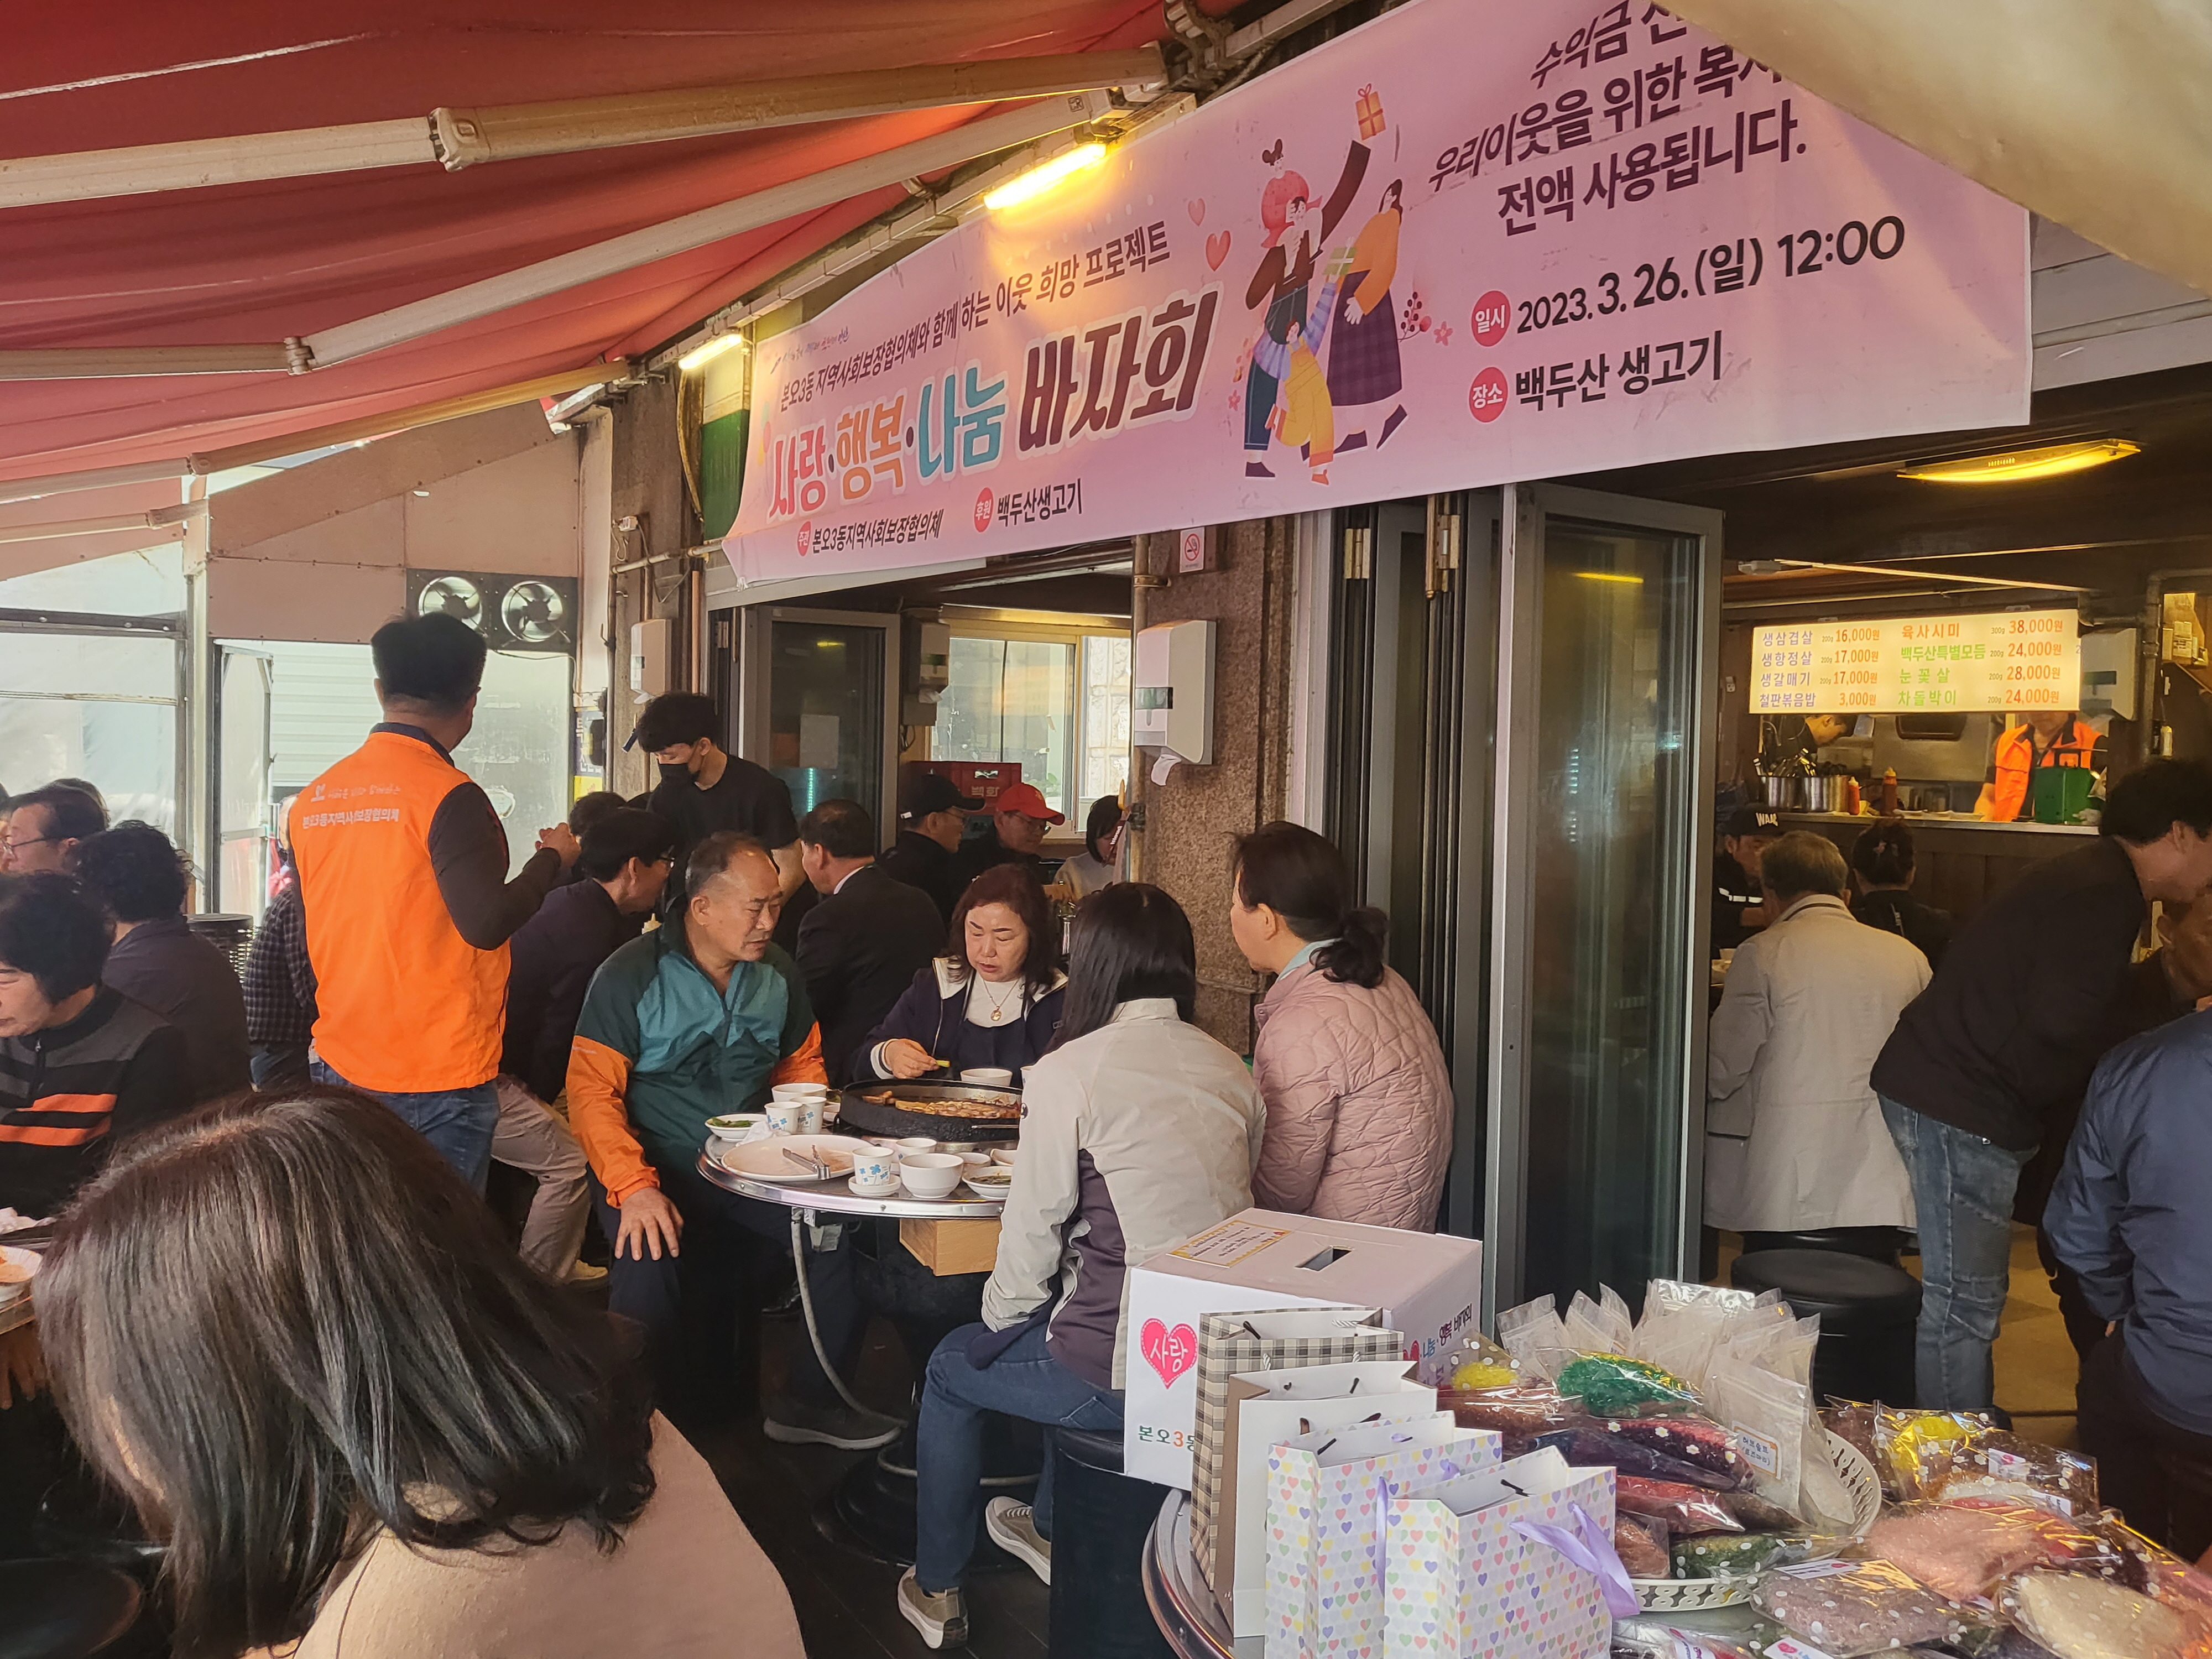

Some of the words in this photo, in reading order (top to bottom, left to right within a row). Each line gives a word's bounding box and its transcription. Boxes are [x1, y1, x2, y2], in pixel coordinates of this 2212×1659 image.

[1530, 0, 1632, 89] 수익금
[1429, 90, 1593, 192] 우리이웃을
[1603, 56, 1687, 133] 위한
[1498, 166, 1574, 236] 전액
[1583, 99, 1806, 209] 사용됩니다.
[1475, 304, 1506, 333] 일시
[1777, 215, 1906, 277] 12:00
[780, 371, 815, 413] 본오3동
[816, 317, 931, 395] 지역사회보장협의체와
[932, 301, 959, 348] 함께
[962, 290, 991, 332] 하는
[997, 273, 1032, 317] 이웃
[1036, 254, 1079, 303] 희망
[1083, 220, 1170, 288] 프로젝트
[1019, 291, 1218, 452] 바자회
[1472, 385, 1504, 409] 장소
[1516, 353, 1609, 412] 백두산
[1618, 330, 1723, 395] 생고기
[975, 498, 992, 521] 후원
[997, 478, 1082, 527] 백두산생고기
[798, 529, 810, 547] 주관
[812, 509, 945, 554] 본오3동지역사회보장협의체
[1762, 630, 1813, 646] 생삼겹살
[1835, 628, 1880, 643] 16,000원
[1902, 623, 1960, 640] 육사시미
[2008, 618, 2063, 635] 38,000원
[1761, 650, 1812, 667] 생항정살
[1834, 649, 1879, 664] 17,000원
[1901, 643, 1986, 661] 백두산특별모듬
[2008, 641, 2062, 658] 24,000원
[1760, 671, 1811, 687] 생갈매기
[1833, 670, 1877, 685] 17,000원
[2006, 665, 2060, 681] 28,000원
[1760, 692, 1816, 708] 철판볶음밥
[1839, 692, 1876, 707] 3,000원
[1897, 690, 1957, 706] 차돌박이
[2005, 688, 2060, 705] 24,000원
[1150, 1333, 1189, 1373] 사랑
